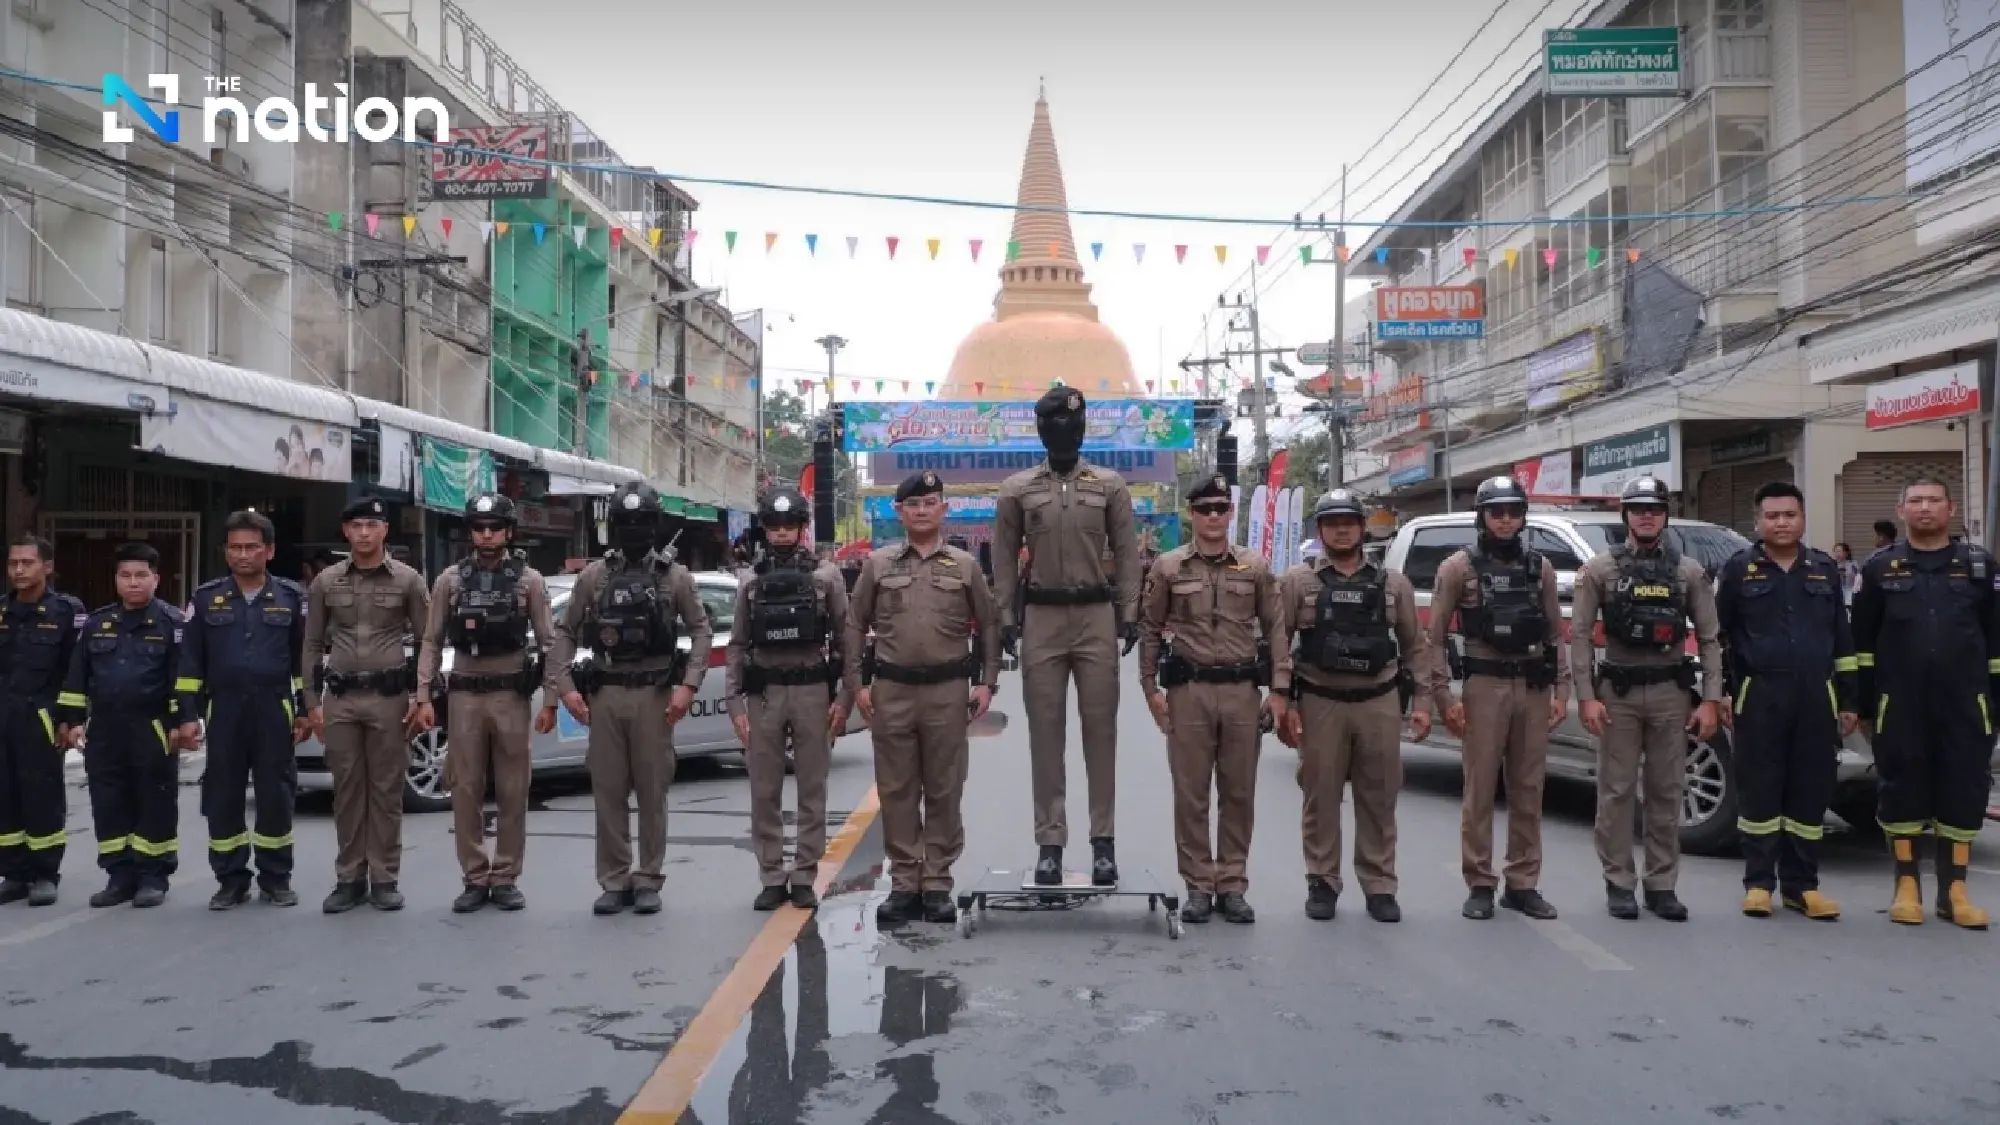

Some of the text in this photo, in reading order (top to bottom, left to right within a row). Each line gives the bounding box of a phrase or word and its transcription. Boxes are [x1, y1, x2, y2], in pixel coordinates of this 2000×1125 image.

[1633, 585, 1670, 598] POLICE
[767, 627, 799, 640] POLICE
[690, 698, 729, 718] OLIC
